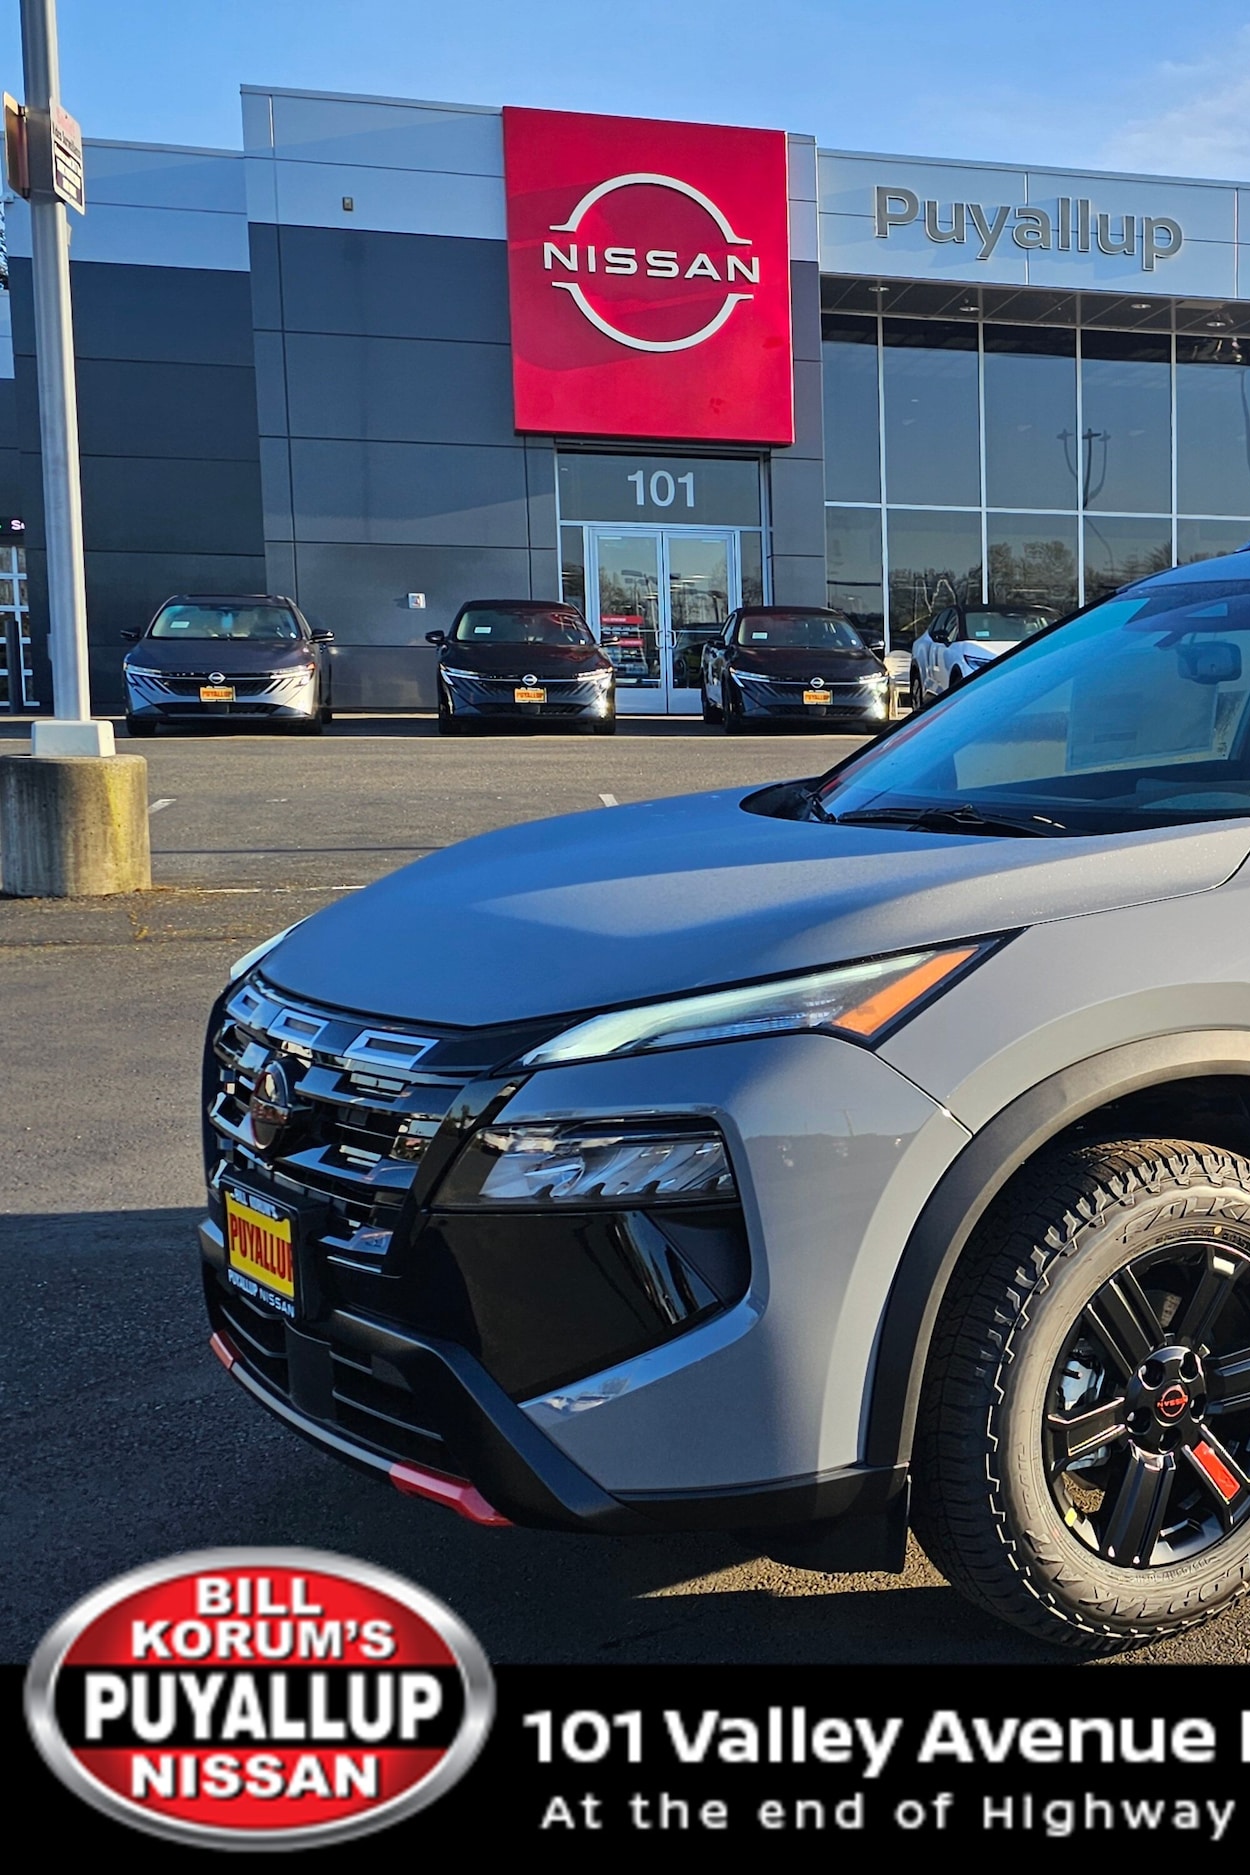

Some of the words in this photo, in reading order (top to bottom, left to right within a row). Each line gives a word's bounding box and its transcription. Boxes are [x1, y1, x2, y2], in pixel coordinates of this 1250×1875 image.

[874, 185, 1184, 271] Puyallup
[543, 241, 760, 283] NISSAN
[627, 470, 695, 507] 101
[259, 1287, 295, 1318] NISSAN
